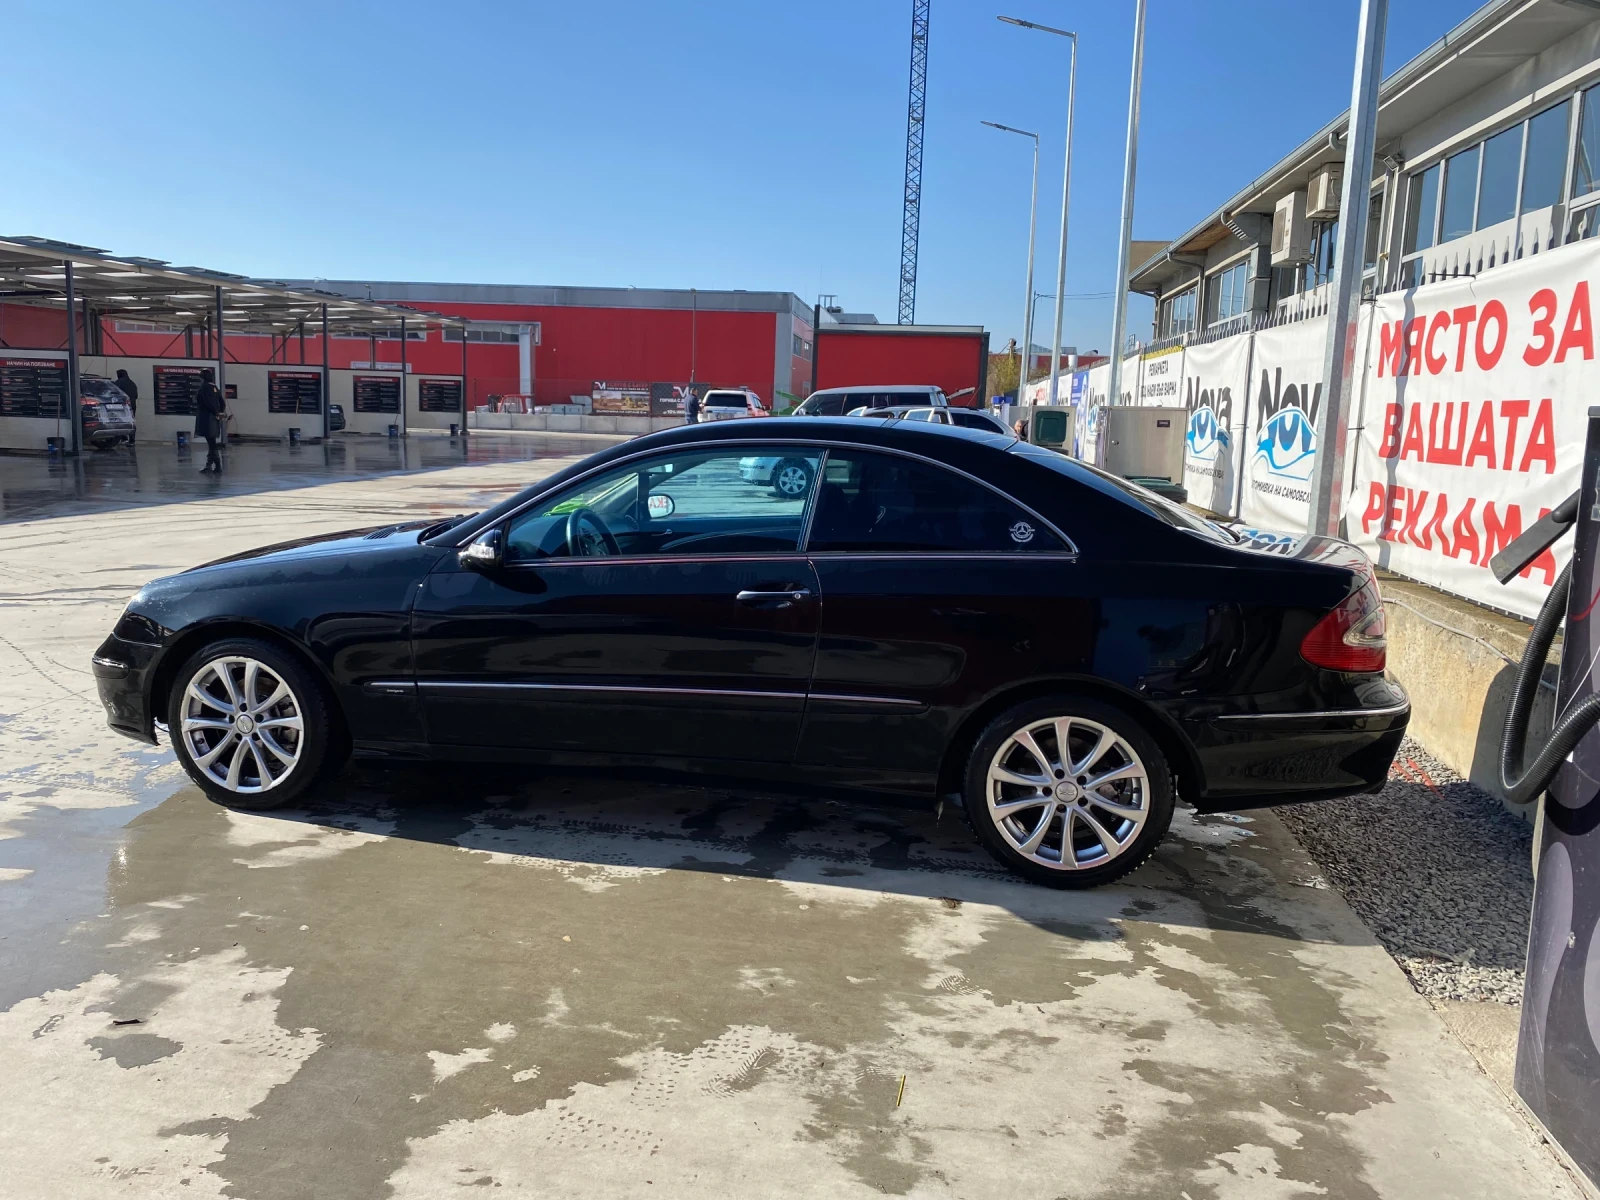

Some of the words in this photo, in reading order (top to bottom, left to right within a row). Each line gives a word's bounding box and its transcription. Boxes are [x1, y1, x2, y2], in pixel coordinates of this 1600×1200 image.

[1377, 299, 1508, 378] МЯСТО
[1523, 280, 1595, 367] ЗА
[1185, 376, 1233, 441] Nova
[1257, 367, 1323, 453] Nov
[1378, 398, 1556, 474] ВАШАТА
